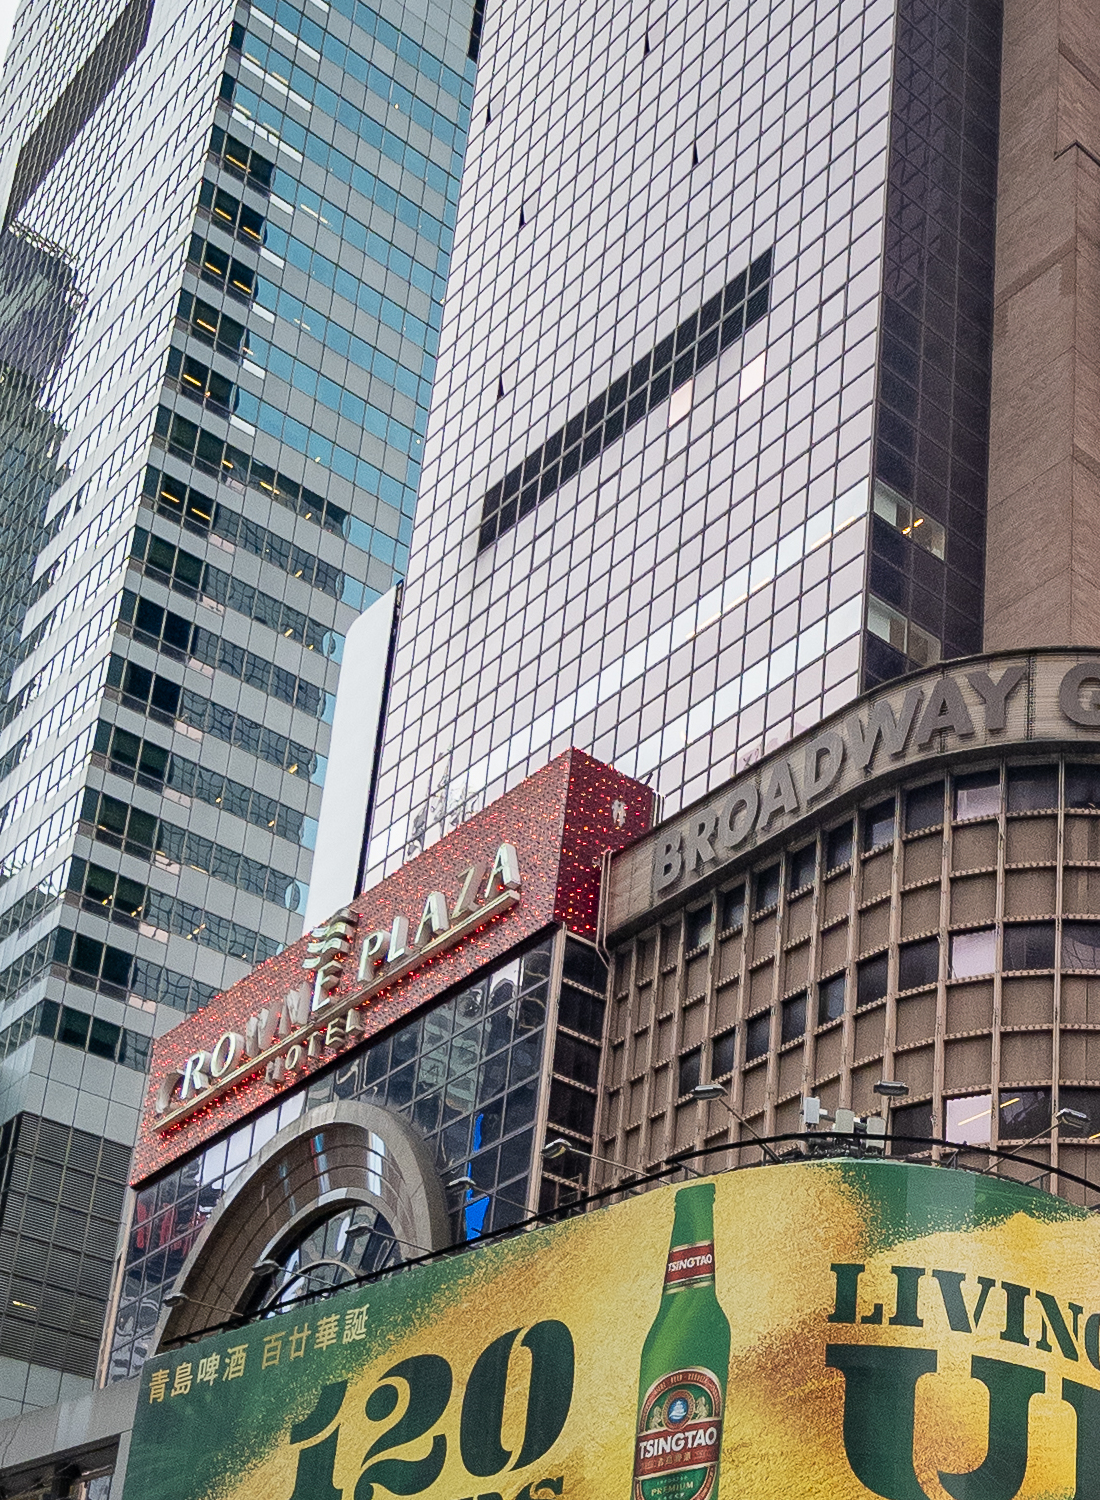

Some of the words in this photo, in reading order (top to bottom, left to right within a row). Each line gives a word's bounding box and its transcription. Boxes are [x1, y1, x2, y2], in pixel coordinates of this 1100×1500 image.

[653, 665, 1028, 893] BROADWAY
[155, 960, 343, 1114] CROWNE
[357, 842, 521, 983] PLAZA
[266, 1007, 364, 1084] HOTEL
[667, 1253, 713, 1274] TSINGTAO
[149, 1343, 249, 1404] 青島啤酒
[261, 1304, 370, 1370] 百廿華誕
[288, 1319, 576, 1500] 120
[639, 1426, 717, 1460] TSINGTAO
